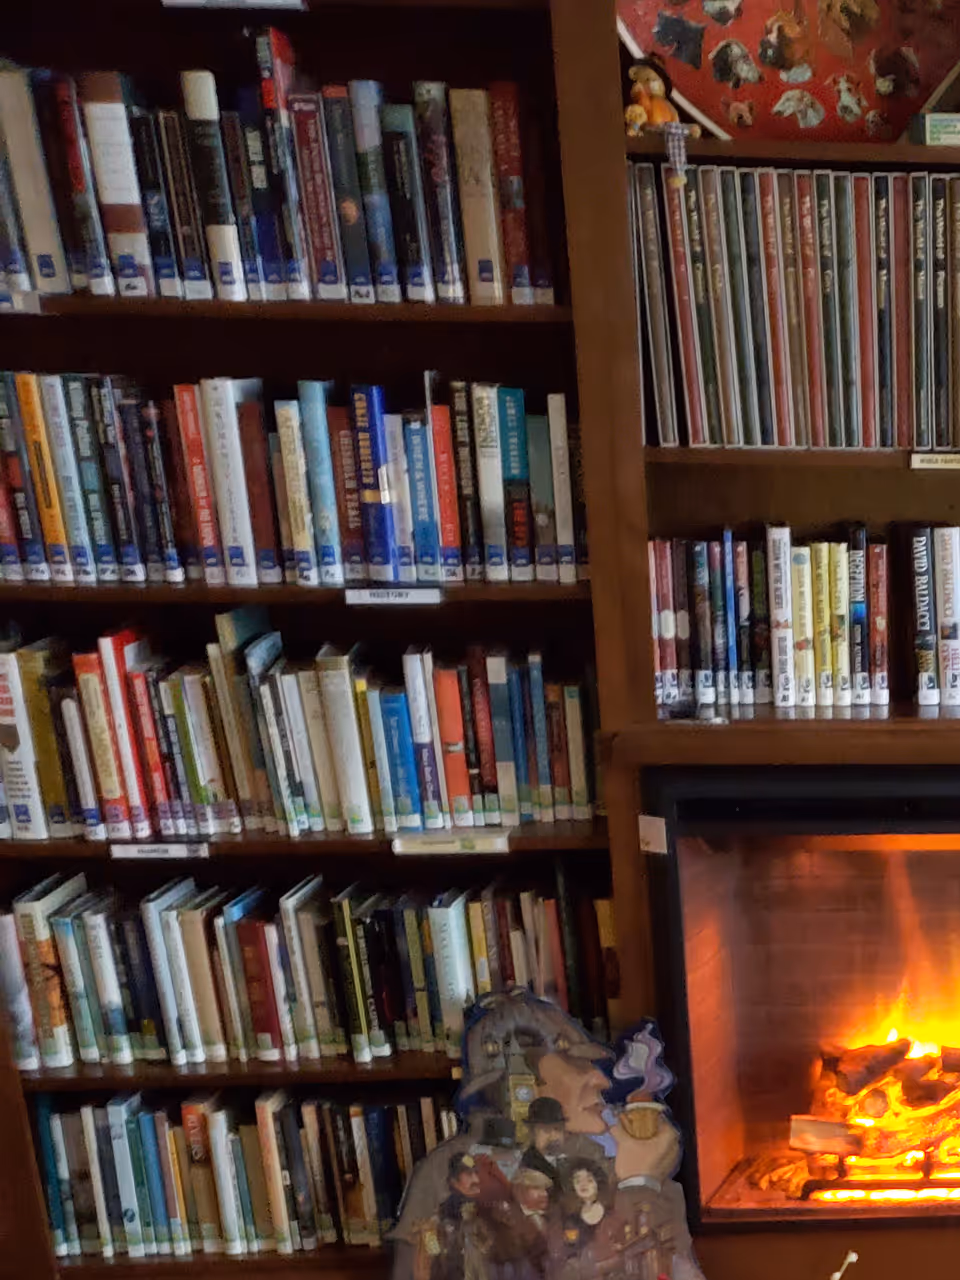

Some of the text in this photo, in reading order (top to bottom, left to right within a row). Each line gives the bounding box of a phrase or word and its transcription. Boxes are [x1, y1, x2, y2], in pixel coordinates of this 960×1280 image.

[850, 549, 865, 602] DECEPTION
[912, 536, 931, 631] DAVID BALDACCI
